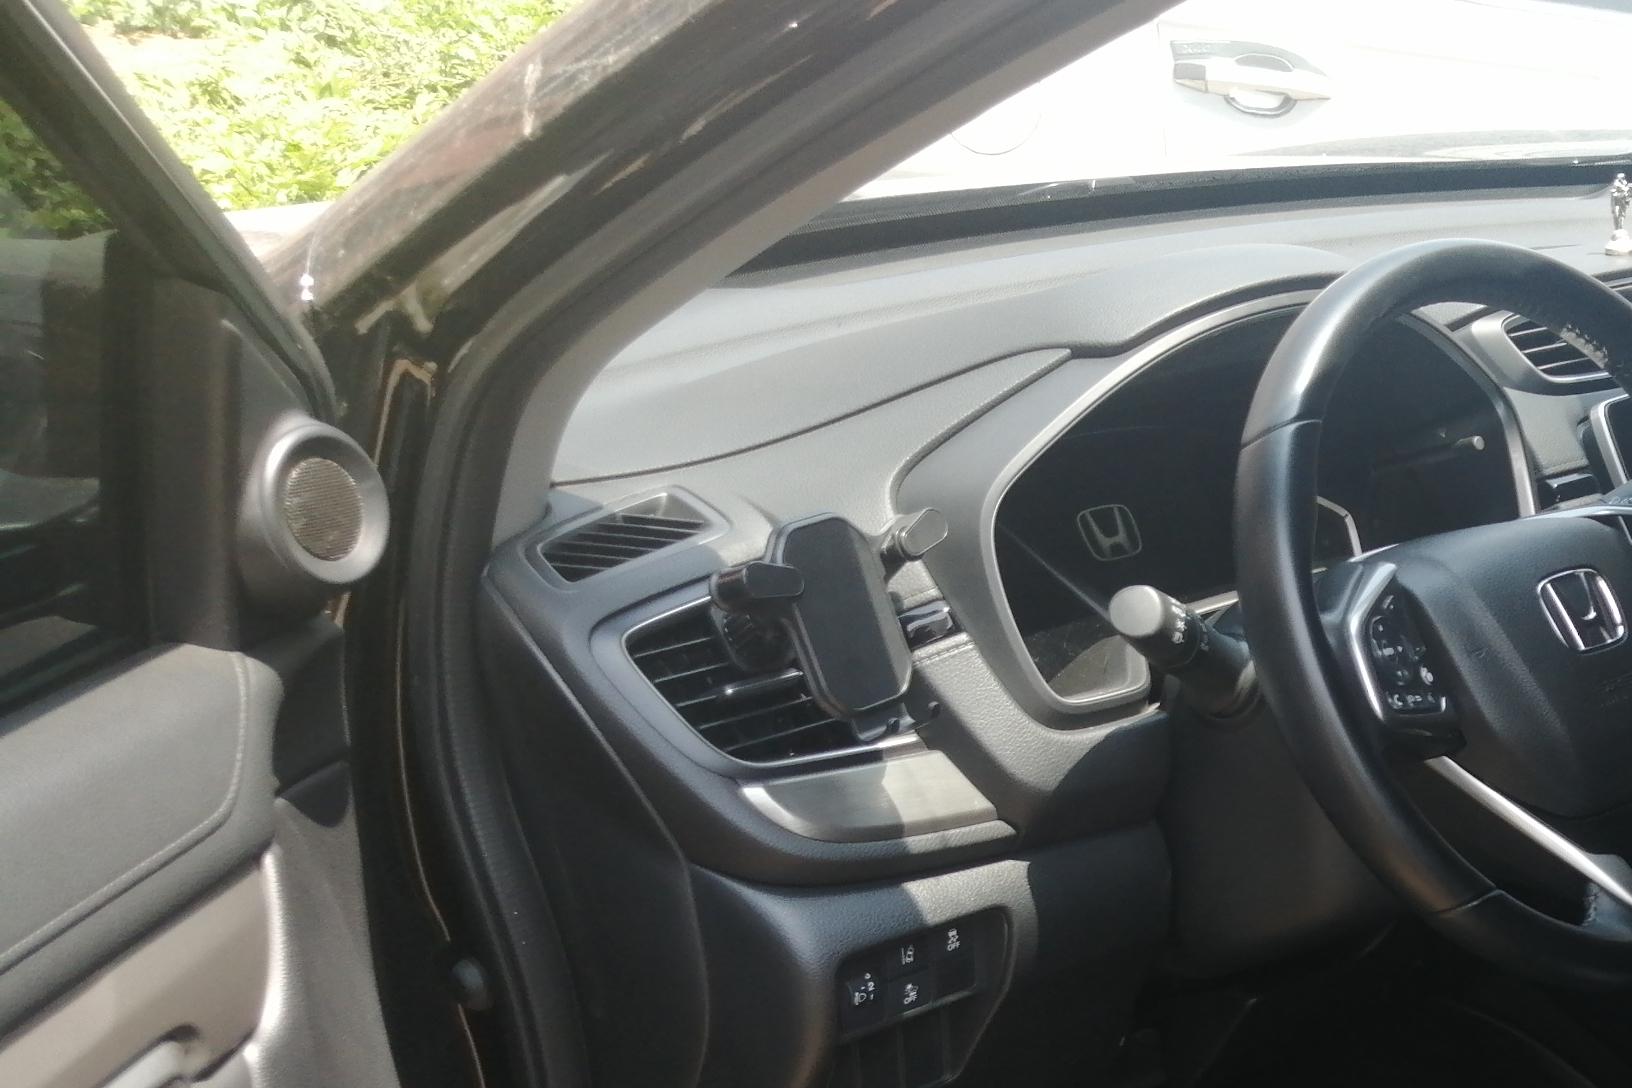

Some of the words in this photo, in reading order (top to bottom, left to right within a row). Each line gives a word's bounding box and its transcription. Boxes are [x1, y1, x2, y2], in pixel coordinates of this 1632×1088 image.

[947, 940, 961, 952] OFF
[867, 982, 875, 991] 2
[903, 994, 918, 1005] OFF
